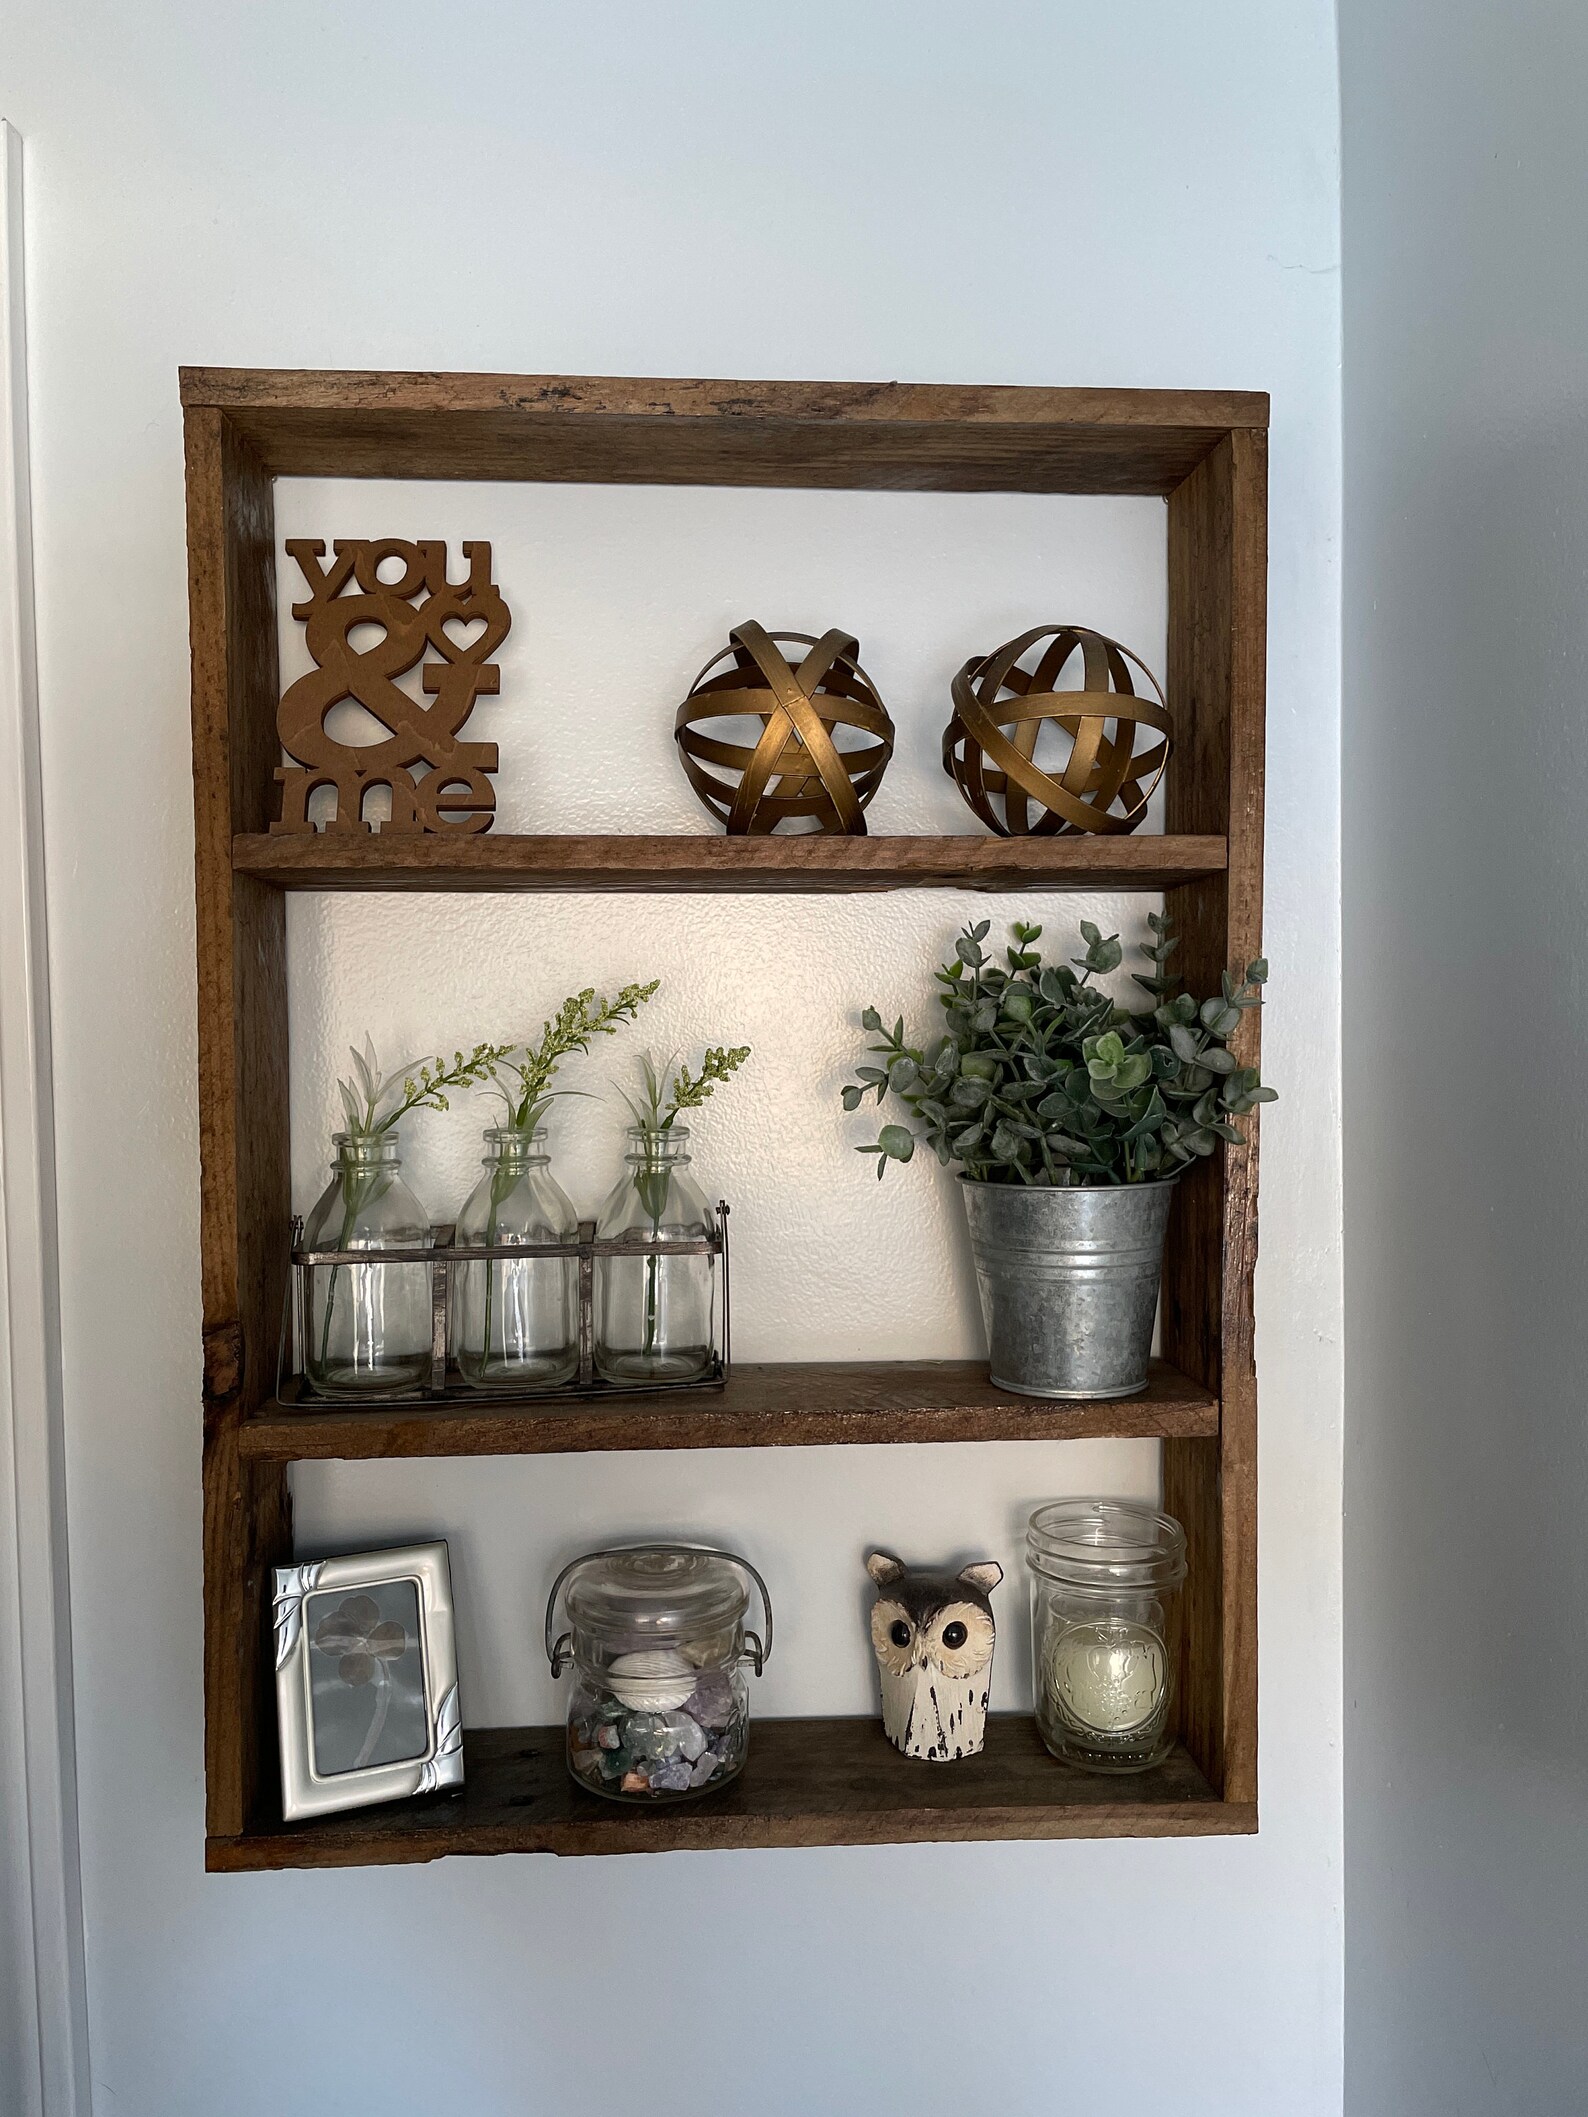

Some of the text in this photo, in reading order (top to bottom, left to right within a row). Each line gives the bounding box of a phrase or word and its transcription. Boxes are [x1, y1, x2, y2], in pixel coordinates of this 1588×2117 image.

[285, 538, 500, 621] you
[276, 594, 500, 773] &
[269, 766, 496, 834] me
